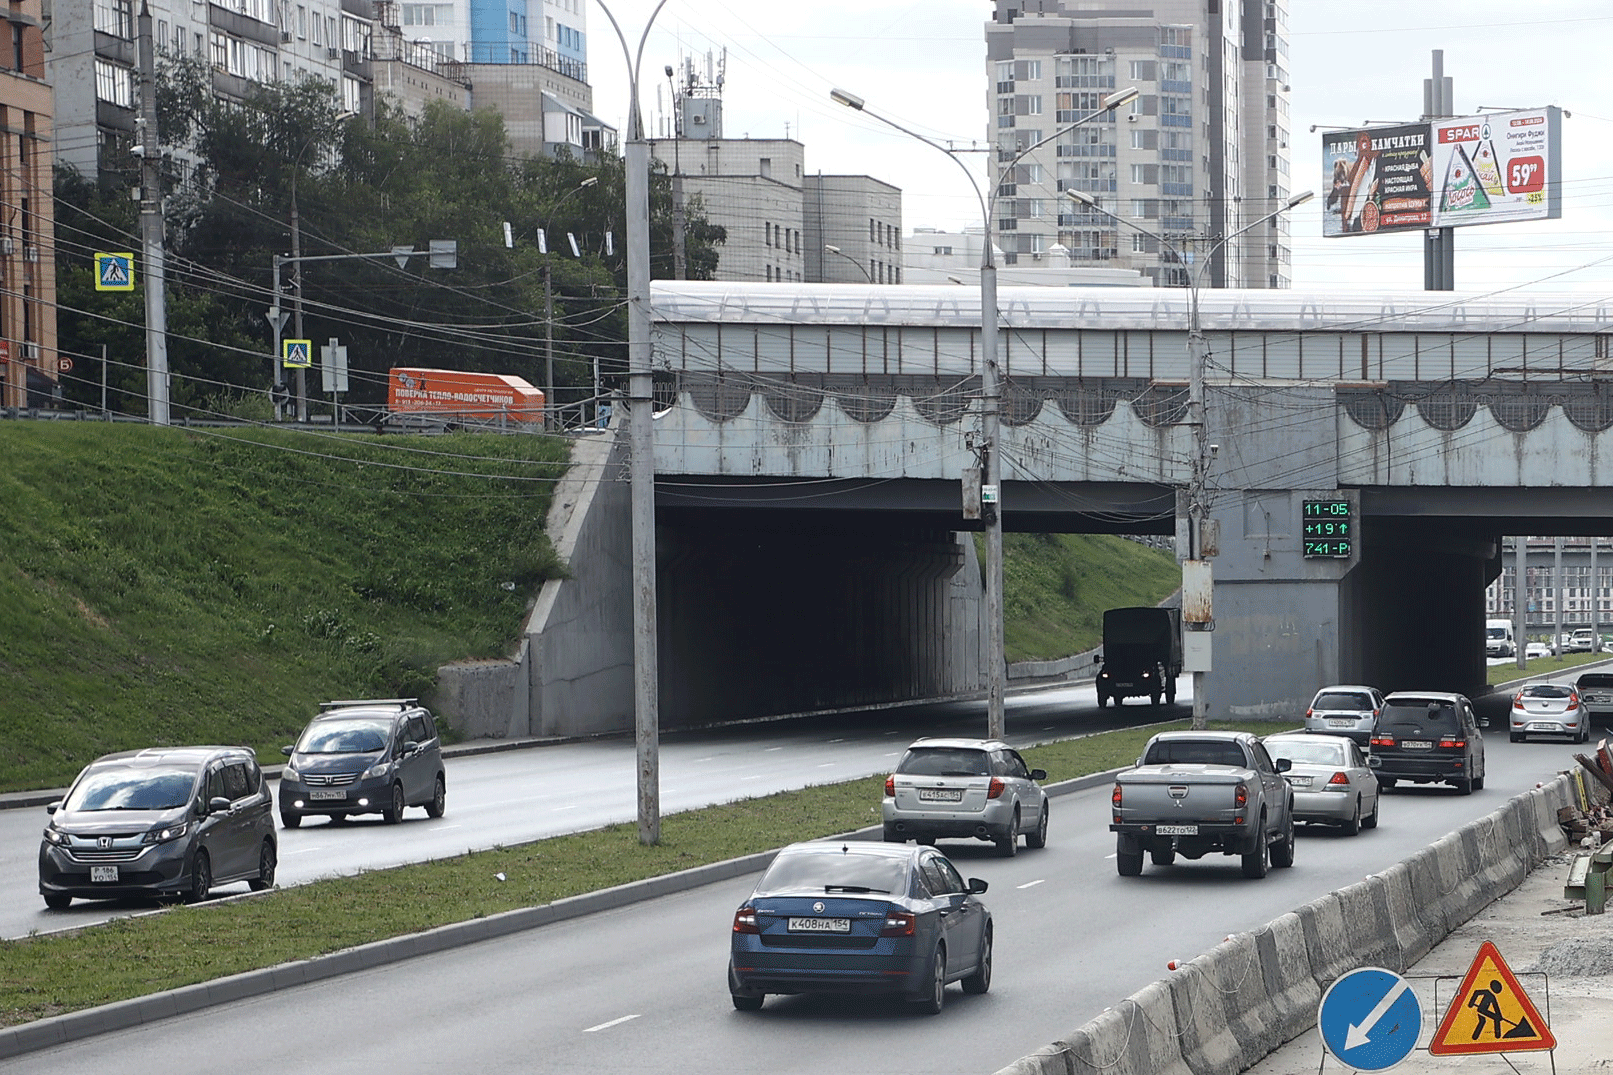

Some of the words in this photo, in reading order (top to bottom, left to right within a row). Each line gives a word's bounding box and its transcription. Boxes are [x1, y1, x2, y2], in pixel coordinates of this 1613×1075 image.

[1446, 127, 1480, 141] SPAR
[1329, 141, 1357, 156] ДАРЫ
[1371, 134, 1425, 151] КАМЧАТКИ
[1384, 163, 1405, 173] КРАСНАЯ
[1384, 175, 1413, 184] НАСТОЯЩАЯ
[1384, 185, 1404, 194] КРАСНАЯ
[1405, 184, 1418, 192] ИКРА
[395, 388, 428, 400] ПОВЕРКА
[1305, 503, 1348, 515] 11-05
[833, 919, 848, 928] 154
